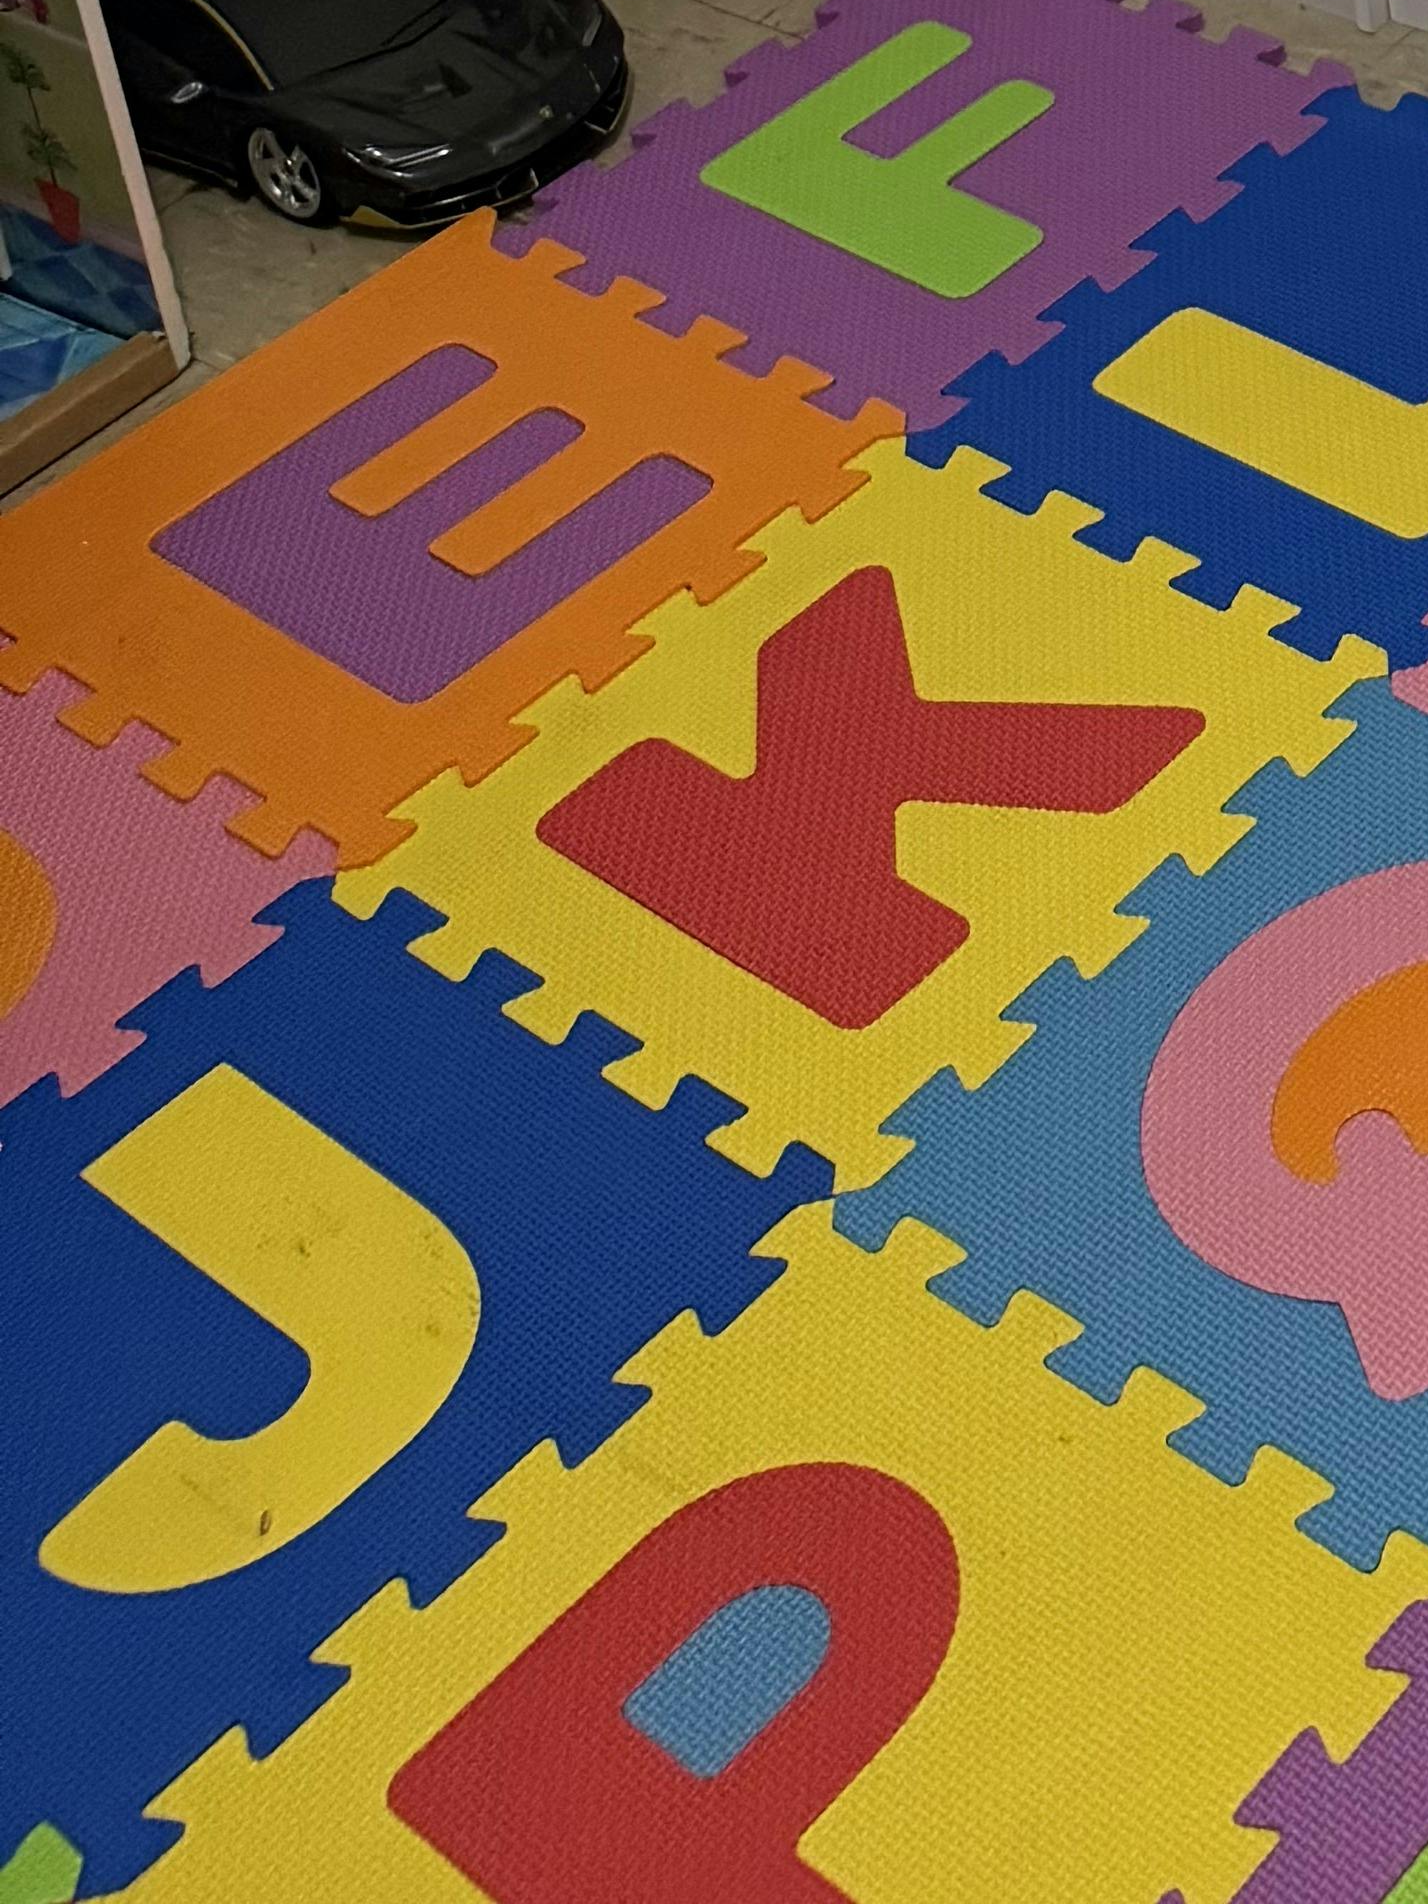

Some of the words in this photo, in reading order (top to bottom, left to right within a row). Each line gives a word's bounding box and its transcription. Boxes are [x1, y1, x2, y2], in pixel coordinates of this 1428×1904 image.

[699, 20, 1055, 298] F
[149, 343, 715, 705] E
[536, 565, 1206, 1029] K
[38, 1063, 481, 1594] J
[386, 1461, 960, 1904] P
